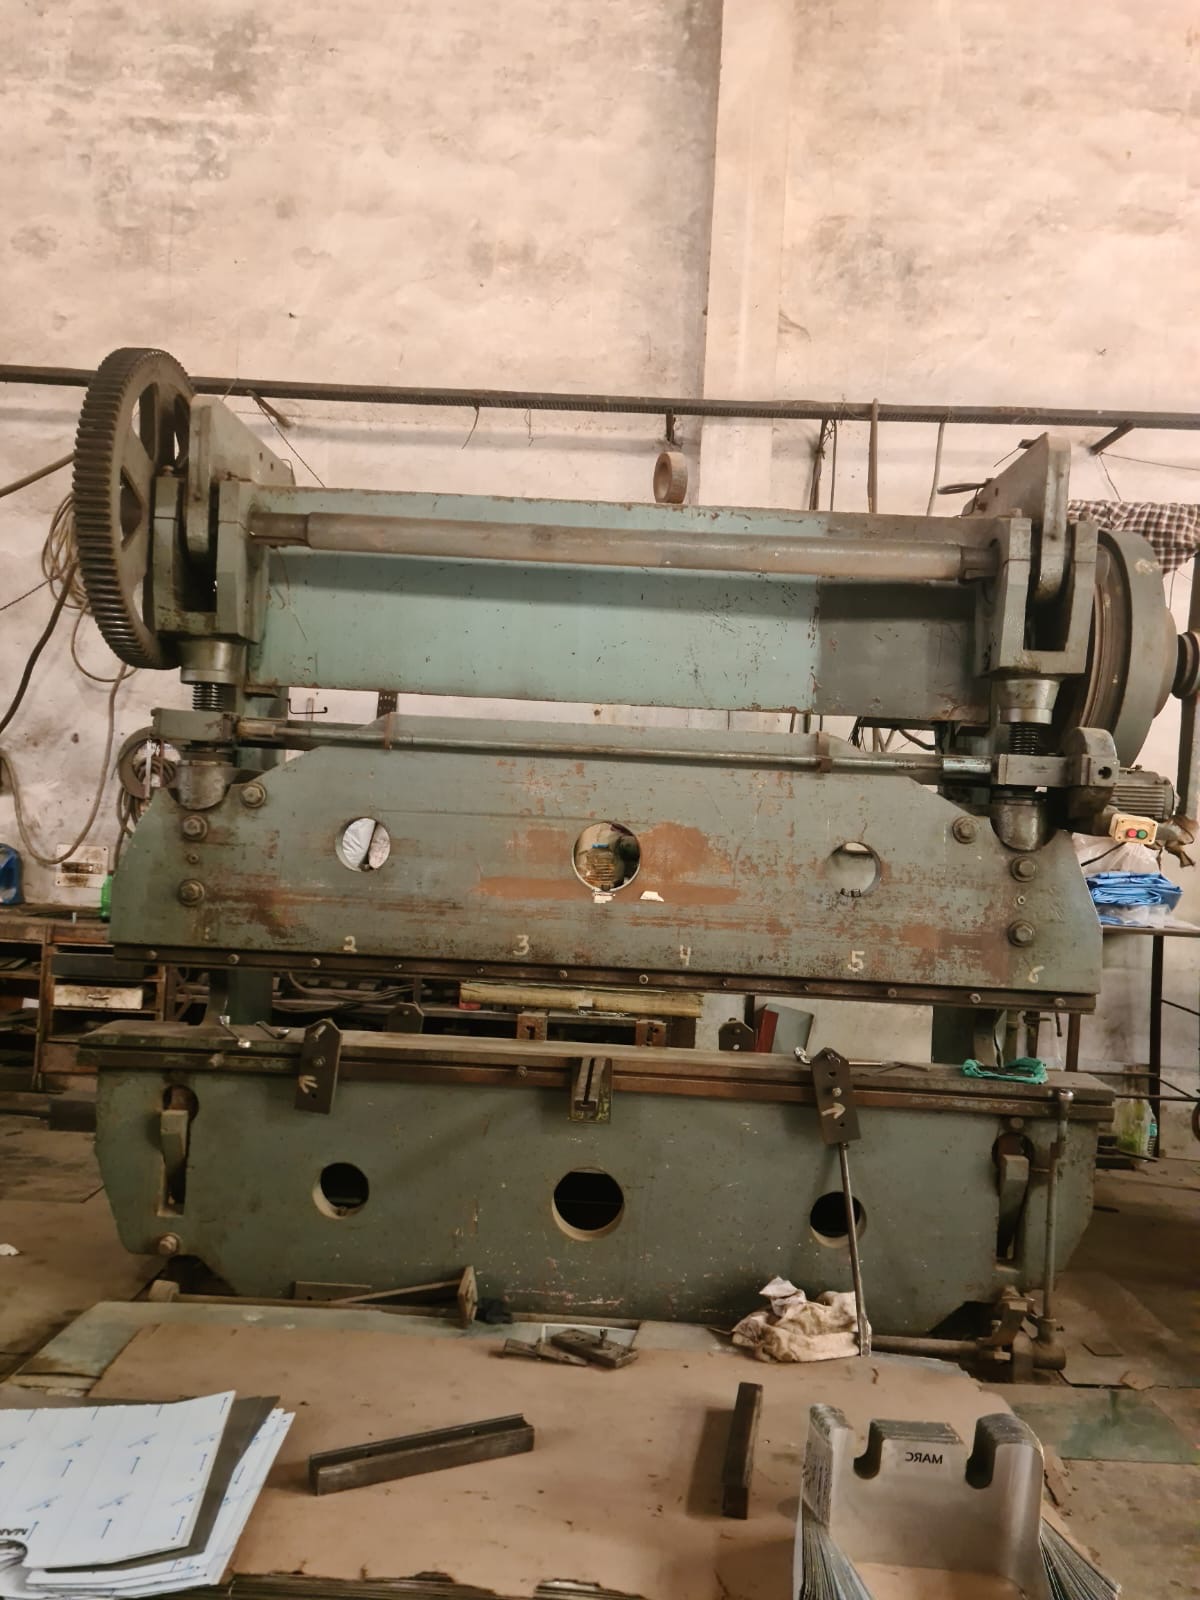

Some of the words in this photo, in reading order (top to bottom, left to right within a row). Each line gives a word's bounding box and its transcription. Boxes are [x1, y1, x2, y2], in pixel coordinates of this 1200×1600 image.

[343, 935, 358, 952] 2
[512, 934, 530, 955] 3
[679, 944, 691, 966] 4
[847, 950, 865, 972] 5
[1029, 965, 1045, 984] 6
